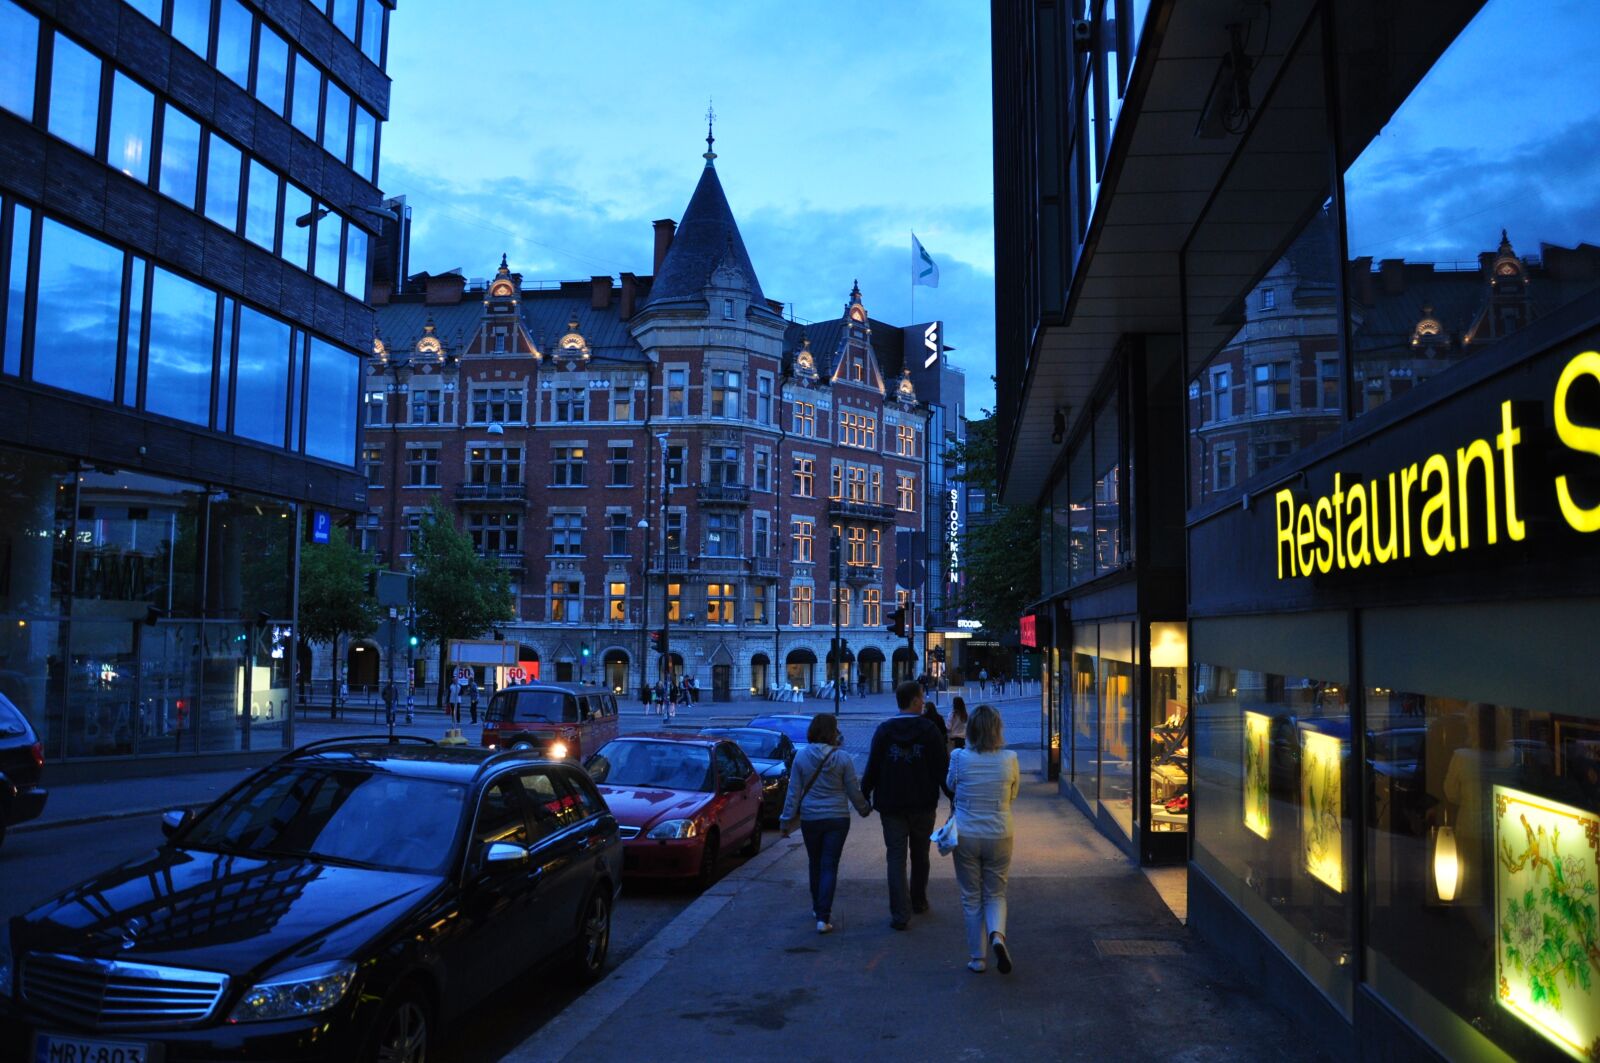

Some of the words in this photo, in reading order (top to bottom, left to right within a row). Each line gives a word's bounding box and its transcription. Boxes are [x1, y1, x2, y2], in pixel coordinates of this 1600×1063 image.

[1275, 400, 1526, 580] Restaurant
[319, 514, 326, 530] P
[50, 1042, 140, 1063] MRY-803
